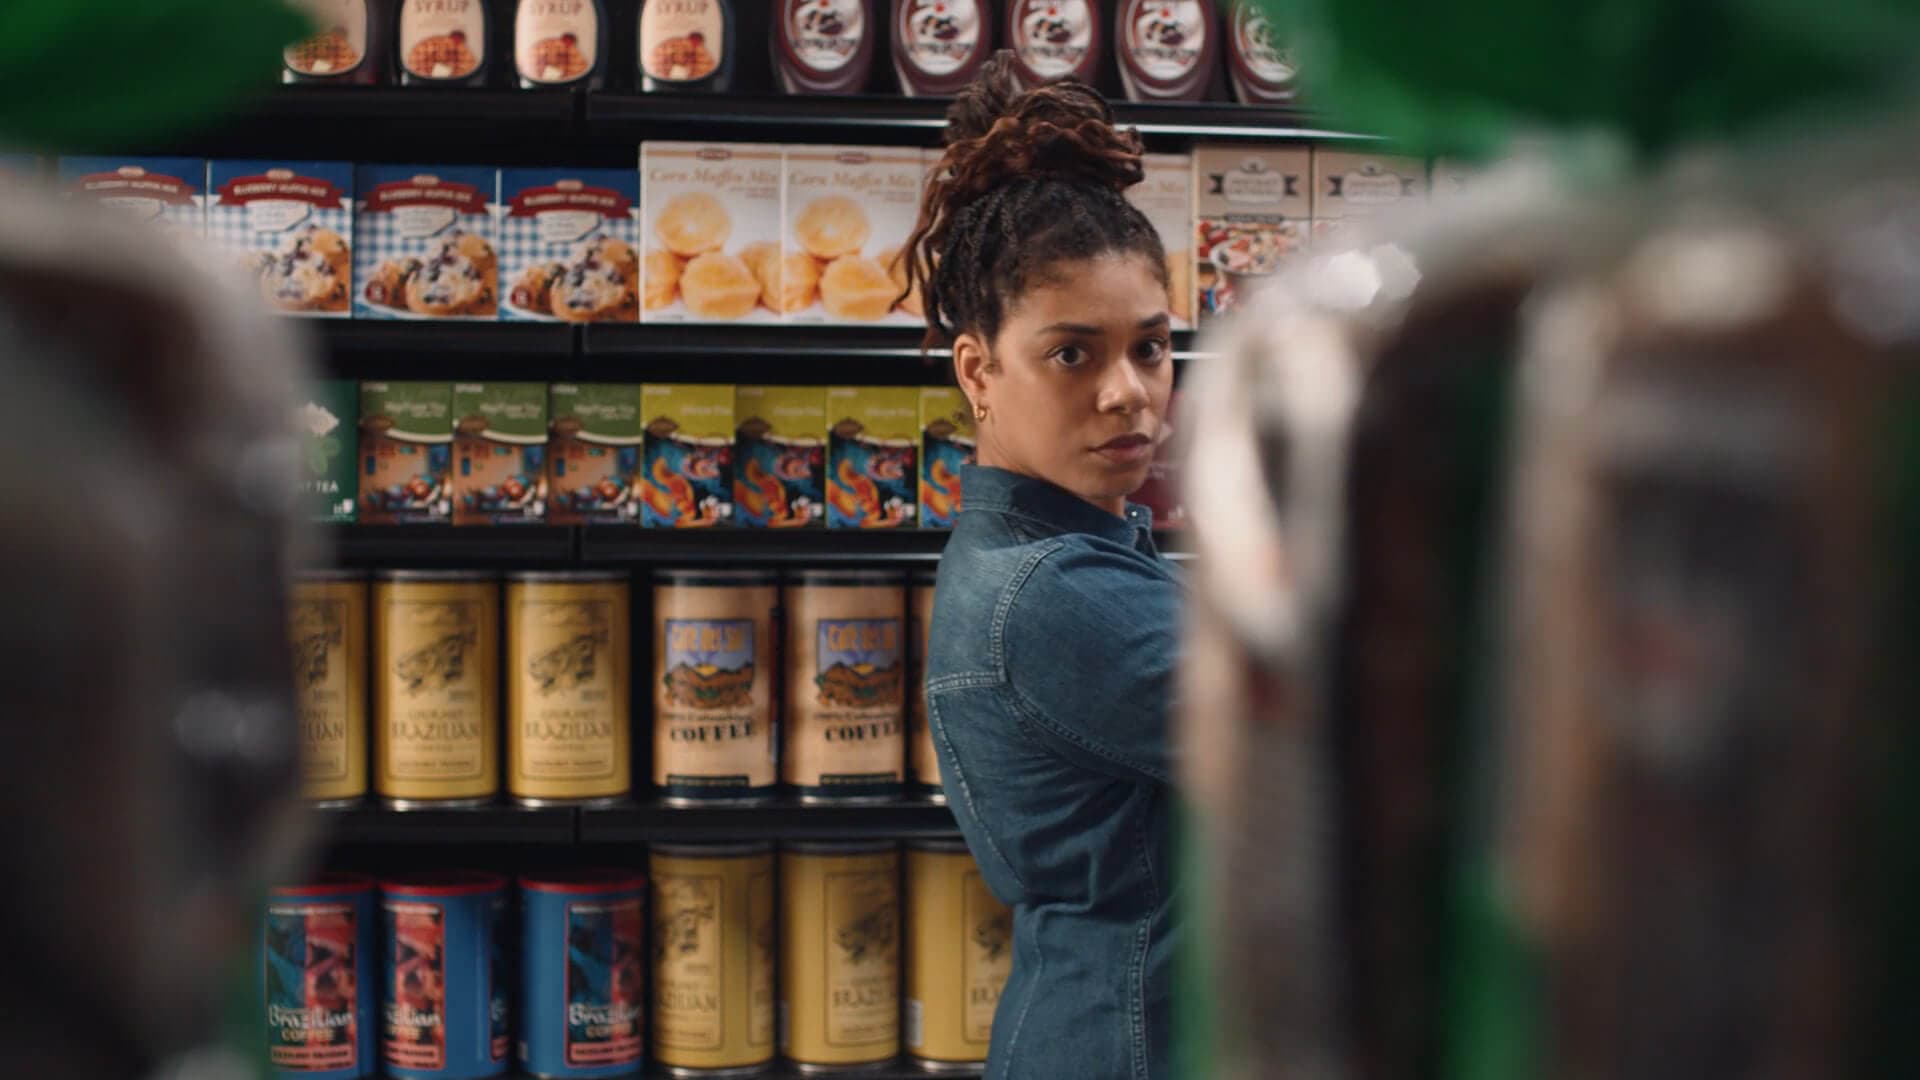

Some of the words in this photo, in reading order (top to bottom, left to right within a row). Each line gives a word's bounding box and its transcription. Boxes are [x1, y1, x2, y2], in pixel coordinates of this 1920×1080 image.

[529, 1, 583, 17] SYRUP
[656, 0, 709, 16] SYRUP
[649, 168, 689, 183] Corn
[693, 167, 743, 188] Muffin
[749, 169, 777, 184] Mix
[788, 170, 828, 186] Corn
[833, 172, 882, 192] Muffin
[888, 174, 916, 187] Mix
[316, 480, 339, 493] TEA
[392, 720, 480, 741] BRAZILIAN
[525, 720, 611, 741] BRAZILIAN
[670, 720, 757, 742] COFFEE
[268, 1003, 354, 1028] Brazilian
